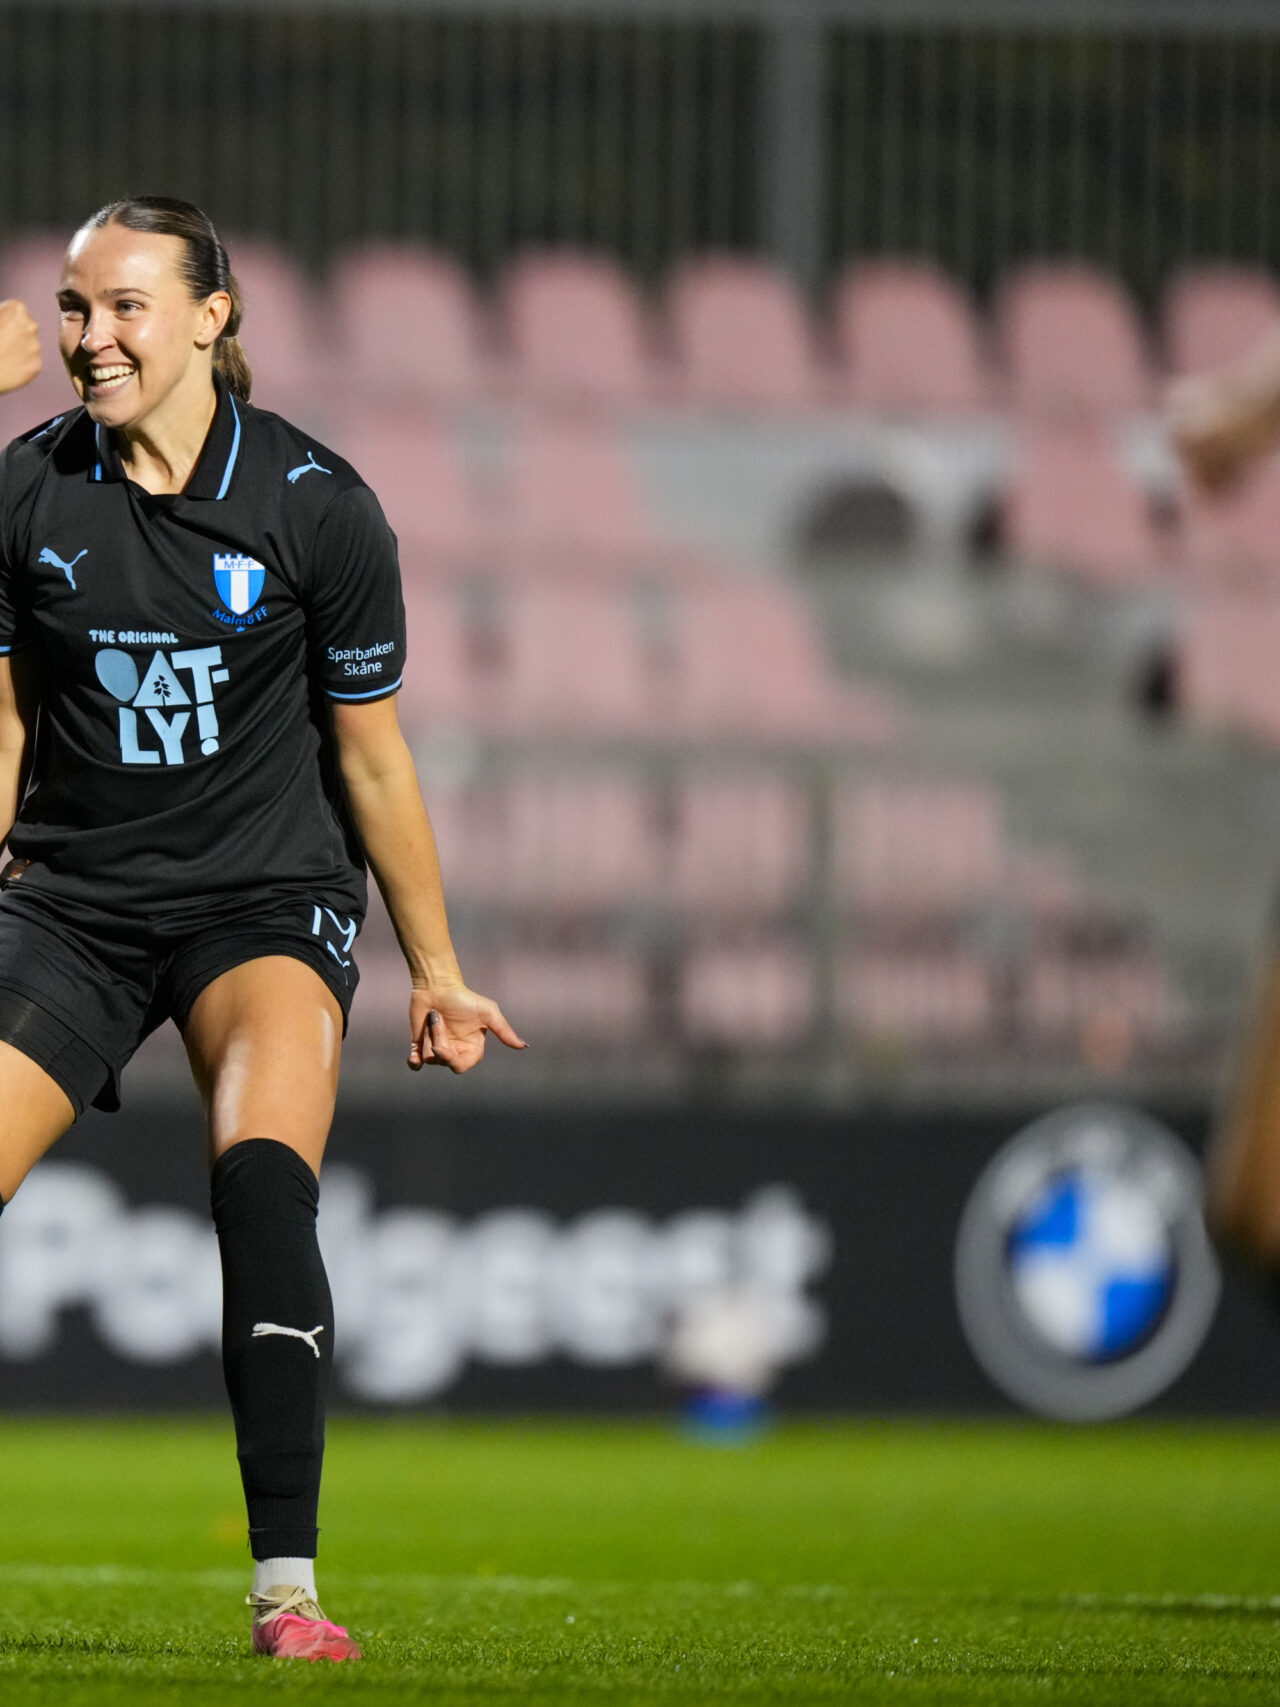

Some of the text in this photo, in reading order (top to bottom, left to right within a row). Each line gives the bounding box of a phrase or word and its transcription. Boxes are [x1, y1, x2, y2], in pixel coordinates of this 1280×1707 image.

[212, 605, 268, 625] Malmö FF
[89, 629, 179, 644] THE ORIGINAL
[327, 641, 395, 663] Sparbanken
[343, 661, 383, 676] Skåne
